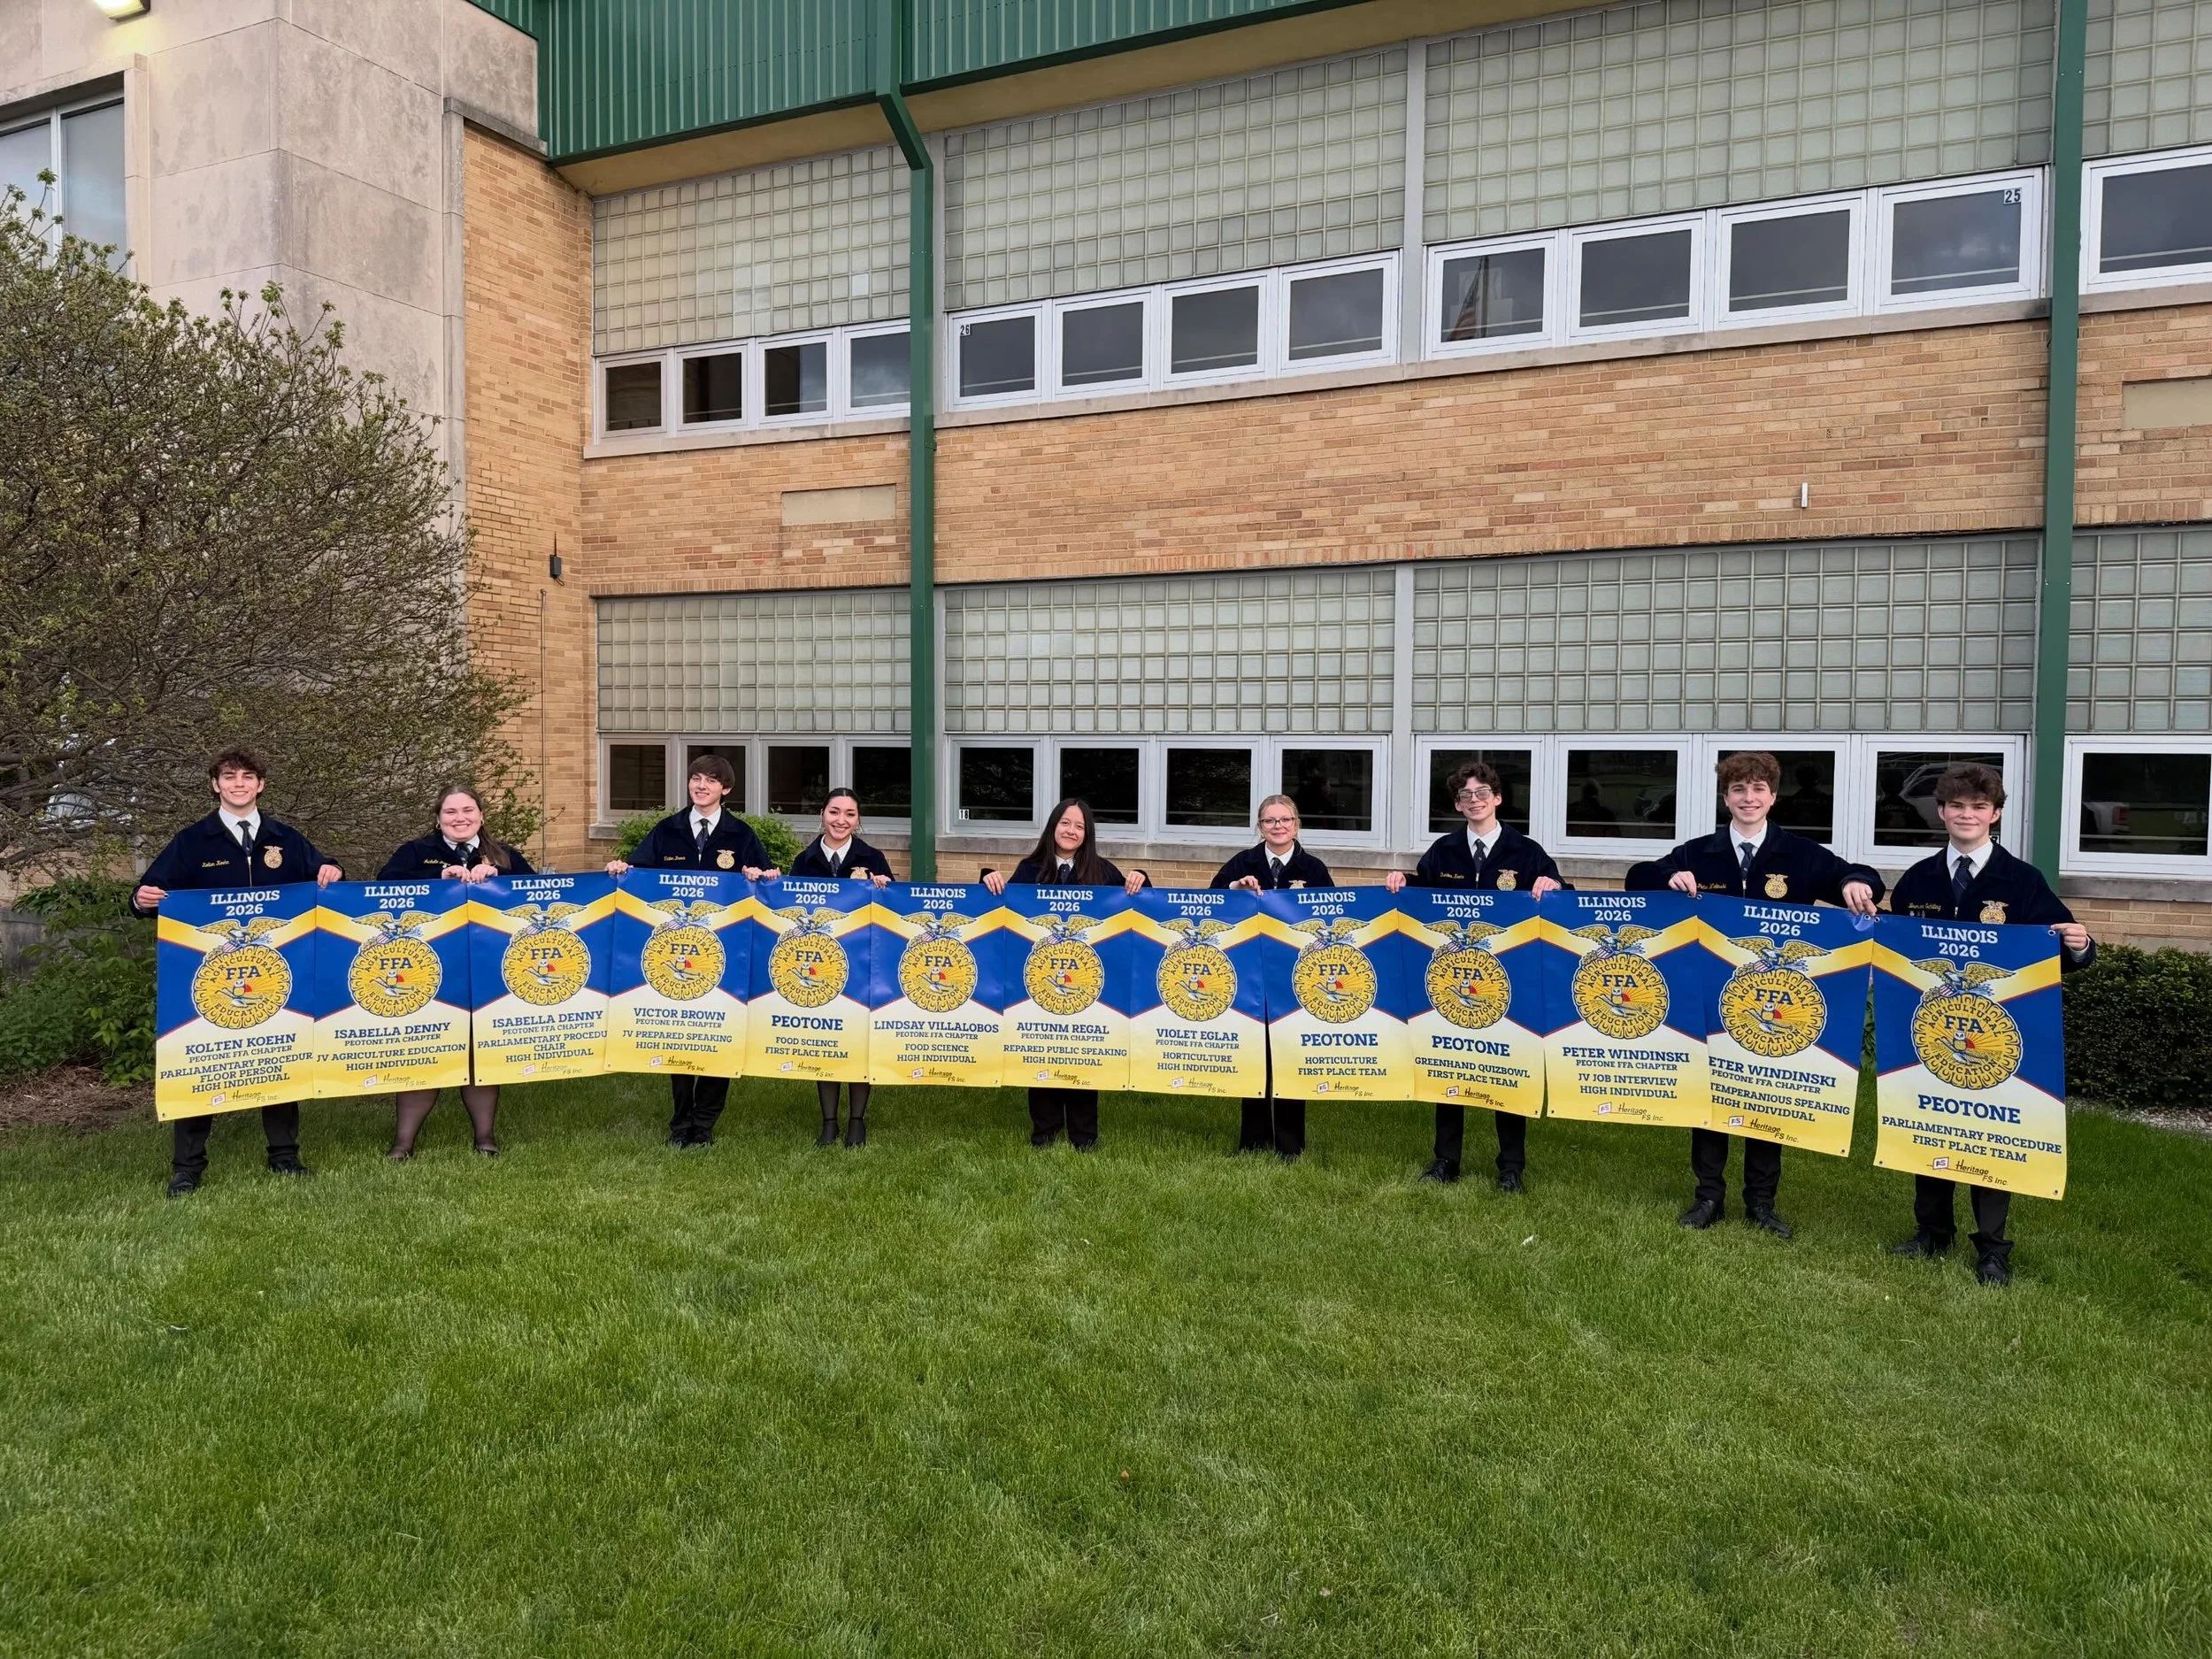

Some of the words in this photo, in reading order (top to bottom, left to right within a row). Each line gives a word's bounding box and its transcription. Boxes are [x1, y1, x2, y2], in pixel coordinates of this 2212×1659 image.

[2005, 188, 2021, 203] 25
[960, 324, 970, 335] 26
[511, 878, 574, 890] ILLINOIS
[659, 874, 718, 886] ILLINOIS
[365, 885, 429, 896] ILLINOIS
[672, 887, 704, 897] 2026
[783, 881, 840, 894] ILLINOIS
[910, 887, 966, 898] ILLINOIS
[211, 890, 280, 904] ILLINOIS
[526, 890, 560, 901] 2026
[795, 894, 826, 904] 2026
[1037, 889, 1094, 901] ILLINOIS
[1168, 894, 1225, 904] ILLINOIS
[1297, 892, 1356, 904] ILLINOIS
[1432, 894, 1494, 906] ILLINOIS
[380, 898, 415, 909] 2026
[924, 900, 954, 910] 2026
[1049, 902, 1080, 911] 2026
[1578, 896, 1646, 908] ILLINOIS
[226, 903, 263, 917] 2026
[1181, 906, 1211, 916] 2026
[1312, 905, 1343, 916] 2026
[1447, 907, 1480, 918] 2026
[1595, 910, 1632, 921] 2026
[1743, 905, 1820, 924] ILLINOIS
[1760, 922, 1801, 936] 2026
[1921, 926, 1998, 943] ILLINOIS
[531, 948, 563, 960] FFA
[670, 944, 701, 956] FFA
[1939, 942, 1980, 957] 2026
[795, 950, 824, 963] FFA
[925, 956, 953, 967] FFA
[380, 957, 413, 971] FFA
[1050, 958, 1079, 970] FFA
[1183, 964, 1212, 975] FFA
[1318, 964, 1349, 975] FFA
[226, 966, 261, 980] FFA
[1452, 967, 1485, 981] FFA
[1602, 975, 1638, 987] FFA
[1738, 979, 1809, 1009] AGRICULTURAL
[1755, 988, 1794, 1006] FFA
[493, 1017, 556, 1028] ISABELLA
[558, 1010, 603, 1022] DENNY
[634, 1008, 678, 1018] VICTOR
[681, 1010, 726, 1021] BROWN
[1928, 1004, 2002, 1037] AGRICULTURAL
[772, 1015, 843, 1031] PEOTONE
[874, 1021, 926, 1030] LINDSAY
[927, 1022, 999, 1033] VILLALOBOS
[1072, 1025, 1110, 1034] REGAL
[1944, 1015, 1985, 1033] FFA
[334, 1027, 401, 1039] ISABELLA
[404, 1022, 450, 1034] DENNY
[635, 1031, 684, 1040] PREPARED
[687, 1033, 733, 1043] SPEAKING
[1156, 1028, 1197, 1039] VIOLET
[1200, 1031, 1239, 1041] EGLAR
[1740, 1023, 1801, 1043] EDUCATION
[185, 1039, 242, 1055] KOLTEN
[247, 1033, 296, 1047] KOEHN
[403, 1033, 441, 1042] CHAPTER
[478, 1034, 561, 1048] PARLIAMENTARY
[564, 1030, 607, 1041] PROCEDU
[802, 1038, 838, 1048] SCIENCE
[1301, 1033, 1379, 1047] PEOTONE
[663, 1042, 718, 1053] INDIVIDUAL
[1432, 1035, 1510, 1056] PEOTONE
[189, 1053, 231, 1063] PEOTONE
[252, 1045, 292, 1055] CHAPTER
[331, 1049, 405, 1061] AGRICULTURE
[408, 1044, 466, 1055] EDUCATION
[506, 1054, 531, 1063] HIGH
[534, 1048, 594, 1060] INDIVIDUAL
[1163, 1052, 1232, 1062] HORTICULTURE
[1563, 1047, 1605, 1058] PETER
[1609, 1049, 1690, 1063] WINDINSKI
[160, 1060, 255, 1079] PARLIAMENTARY
[257, 1052, 312, 1066] PROCEDUR
[376, 1057, 438, 1069] INDIVIDUAL
[1048, 1057, 1102, 1066] INDIVIDUAL
[1415, 1056, 1476, 1071] GREENHAND
[1479, 1064, 1530, 1078] QUIZBOWL
[1934, 1053, 1998, 1076] EDUCATION
[200, 1071, 236, 1083] FLOOR
[240, 1065, 282, 1078] PERSON
[1183, 1064, 1238, 1073] INDIVIDUAL
[1709, 1056, 1744, 1072] ETER
[1747, 1064, 1836, 1087] WINDINSKI
[192, 1082, 220, 1094] HIGH
[224, 1073, 290, 1089] INDIVIDUAL
[1427, 1070, 1454, 1079] FIRST
[1457, 1072, 1486, 1083] PLACE
[1490, 1077, 1518, 1087] TEAM
[1614, 1075, 1678, 1086] INTERVIEW
[1712, 1069, 1753, 1084] PEOTONE
[1755, 1078, 1772, 1087] FFA
[1775, 1081, 1821, 1094] CHAPTER
[1580, 1086, 1607, 1094] HIGH
[1610, 1087, 1678, 1099] INDIVIDUAL
[1710, 1082, 1792, 1105] TEMPERANIOUS
[1794, 1098, 1850, 1115] SPEAKING
[1712, 1095, 1740, 1108] HIGH
[1743, 1102, 1816, 1122] INDIVIDUAL
[1917, 1094, 2021, 1125] PEOTONE
[1750, 1118, 1781, 1133] Heritage
[1882, 1116, 1984, 1141] PARLIAMENTARY
[1986, 1133, 2062, 1154] PROCEDURE
[1913, 1134, 1946, 1148] FIRST
[1948, 1141, 1987, 1156] PLACE
[1990, 1148, 2027, 1163] TEAM
[1956, 1159, 1989, 1175] Heritage
